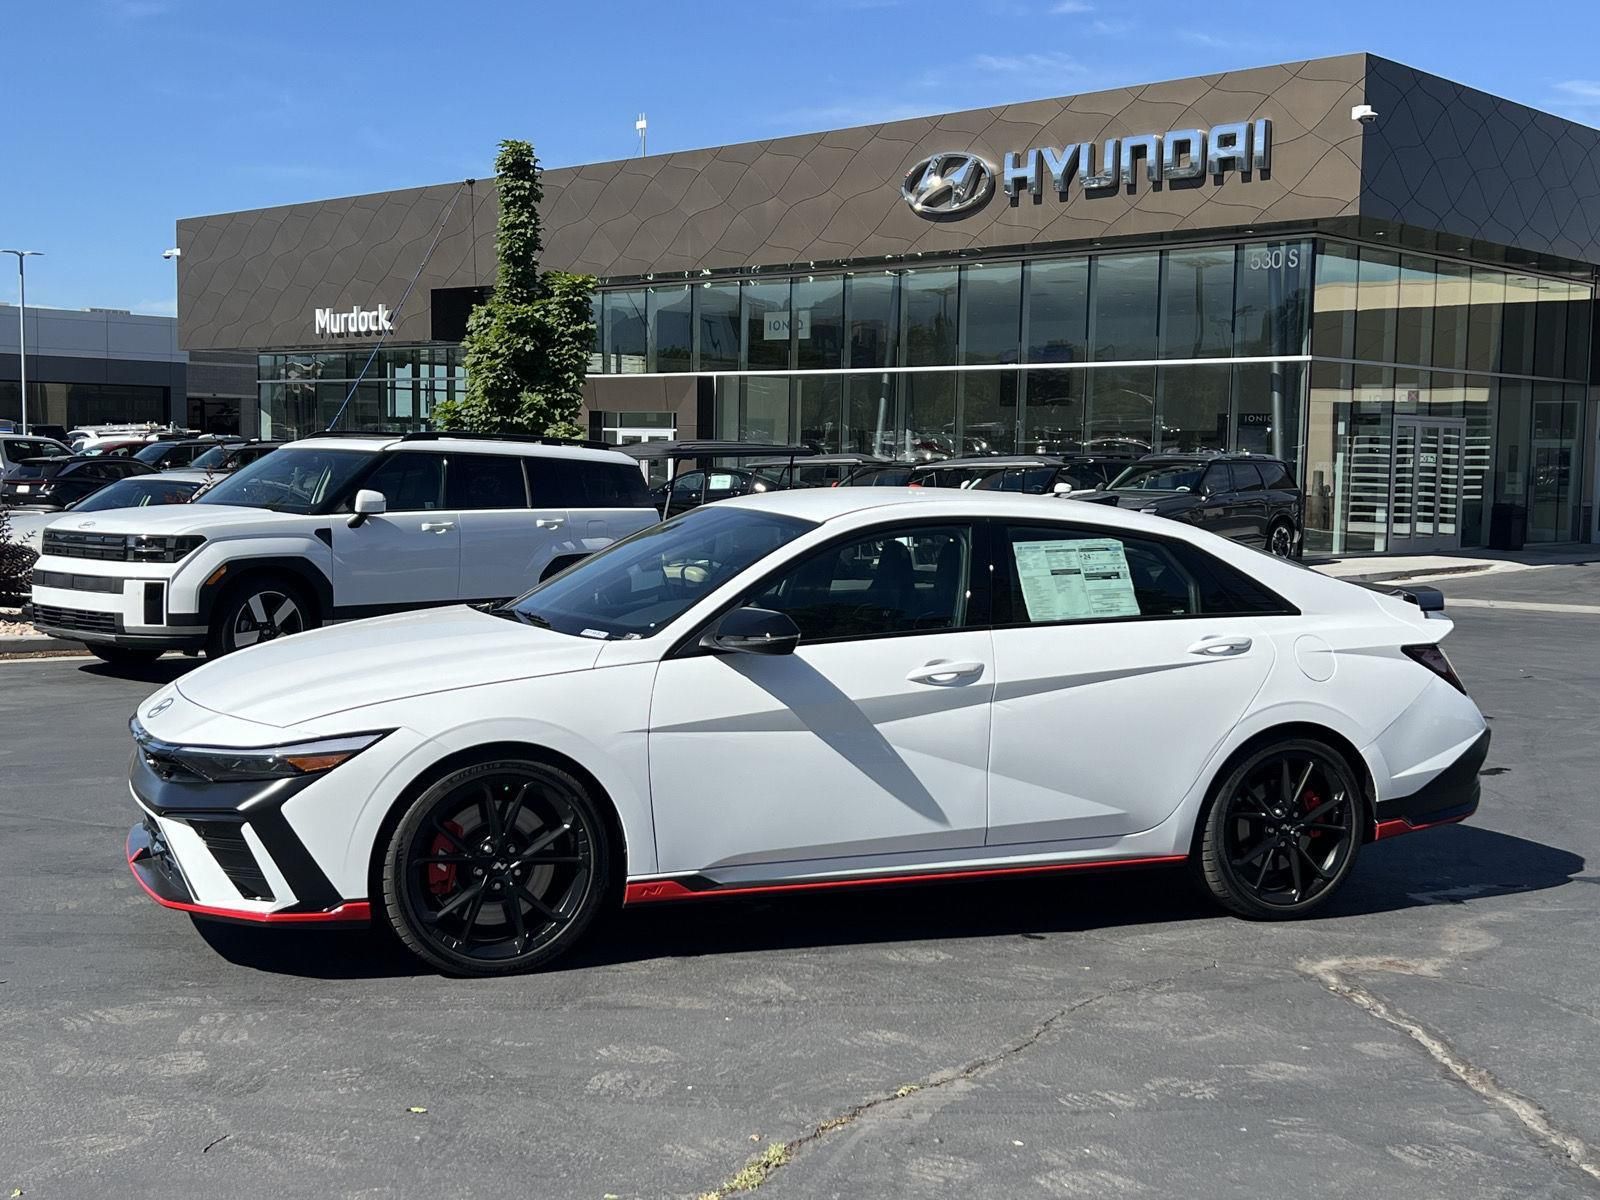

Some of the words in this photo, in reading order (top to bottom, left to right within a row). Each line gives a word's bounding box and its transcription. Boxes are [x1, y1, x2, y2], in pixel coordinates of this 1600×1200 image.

[1003, 118, 1271, 206] HYUNDAI
[1250, 250, 1282, 270] 530
[1288, 248, 1299, 268] S
[315, 303, 394, 335] Murdock
[768, 320, 804, 331] IONQ
